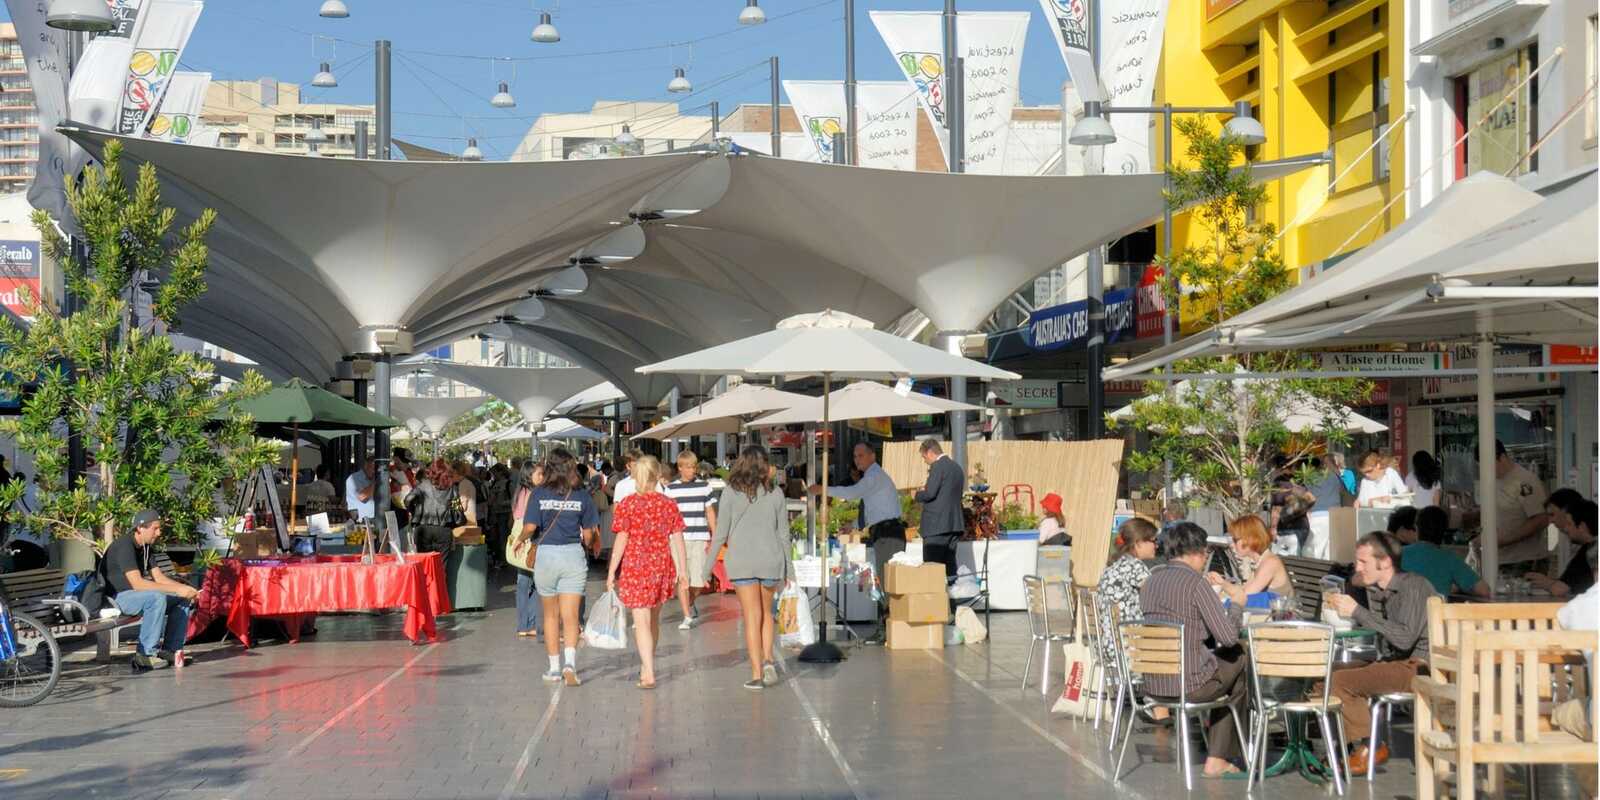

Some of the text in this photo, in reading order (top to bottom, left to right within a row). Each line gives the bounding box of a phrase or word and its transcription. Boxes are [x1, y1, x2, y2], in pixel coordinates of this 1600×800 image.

[121, 109, 135, 131] THE
[1331, 354, 1425, 365] A Taste of Home
[1016, 387, 1056, 398] SECRE
[1394, 407, 1402, 450] OPEN
